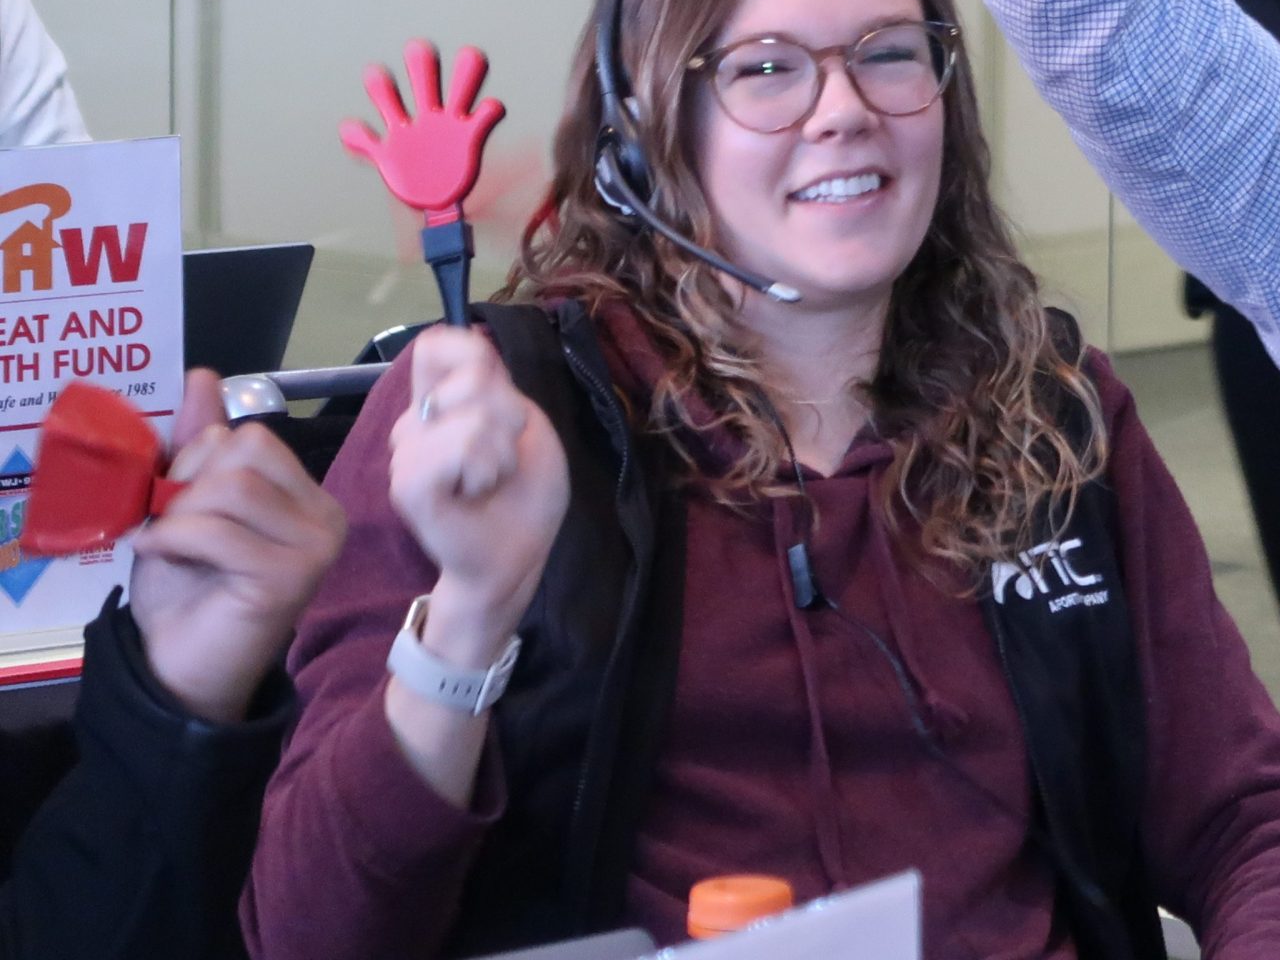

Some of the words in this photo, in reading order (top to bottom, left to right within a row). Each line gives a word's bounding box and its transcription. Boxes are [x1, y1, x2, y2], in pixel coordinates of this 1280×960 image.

[59, 306, 143, 341] AND
[53, 343, 151, 379] FUND
[20, 393, 43, 409] and
[127, 382, 156, 397] 1985
